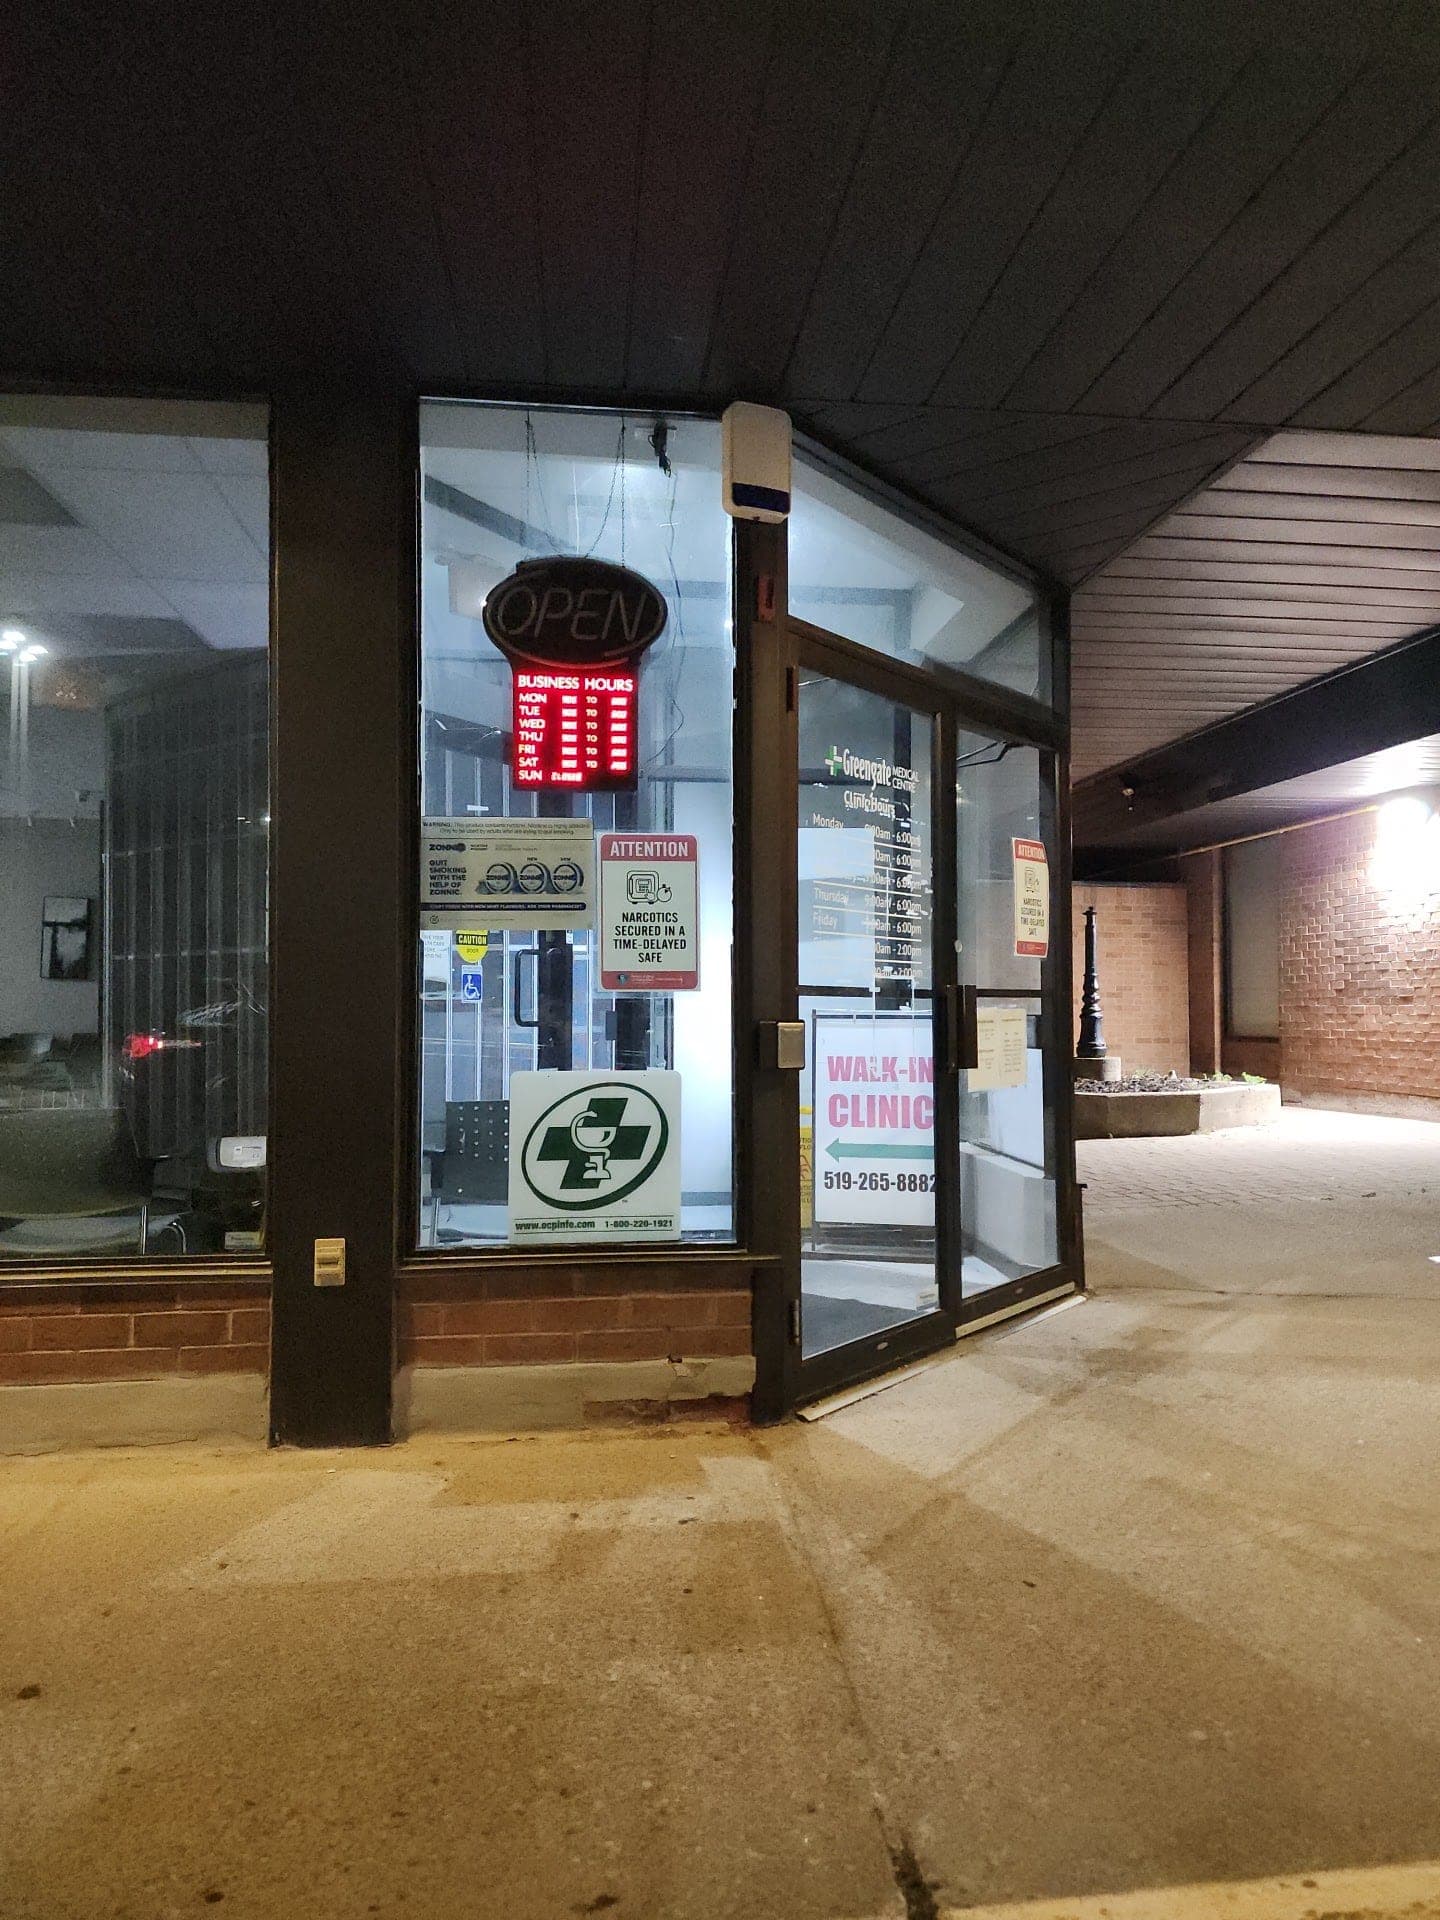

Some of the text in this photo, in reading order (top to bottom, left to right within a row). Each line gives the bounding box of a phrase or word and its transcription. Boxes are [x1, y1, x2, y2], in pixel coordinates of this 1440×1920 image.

[498, 586, 648, 641] OPEN
[517, 675, 633, 692] BUSINESS HOURS
[519, 692, 547, 704] MON
[585, 696, 597, 704] TO
[519, 705, 541, 716] TUE
[585, 709, 597, 717] TO
[519, 718, 546, 729] WED
[585, 721, 597, 730] TO
[519, 731, 543, 742] THU
[585, 734, 597, 743] TO
[518, 744, 535, 755] FRI
[585, 747, 597, 755] TO
[518, 757, 539, 768] SAT
[585, 760, 597, 769] TO
[843, 748, 892, 791] Greengate
[518, 770, 543, 781] SUN
[892, 766, 920, 783] MEDICAL
[892, 777, 916, 793] CENTRE
[812, 812, 844, 829] Monday
[610, 841, 688, 857] ATTENTION
[814, 887, 849, 904] Thursday
[896, 899, 922, 915] 6:00pm
[621, 912, 678, 923] NARCOTICS
[812, 911, 838, 930] Friday
[896, 921, 922, 936] 6:00pm
[615, 925, 686, 936] SECURED IN A
[458, 935, 487, 945] CAUTION
[613, 938, 687, 949] TIME-DELAYED
[638, 952, 663, 963] SAFE
[897, 943, 922, 959] 2:00pm
[827, 1056, 934, 1083] WALK-IN
[828, 1094, 934, 1129] CLINIC
[824, 1171, 936, 1193] 519-265-8882
[515, 1220, 595, 1231] www.ocpinfo.com
